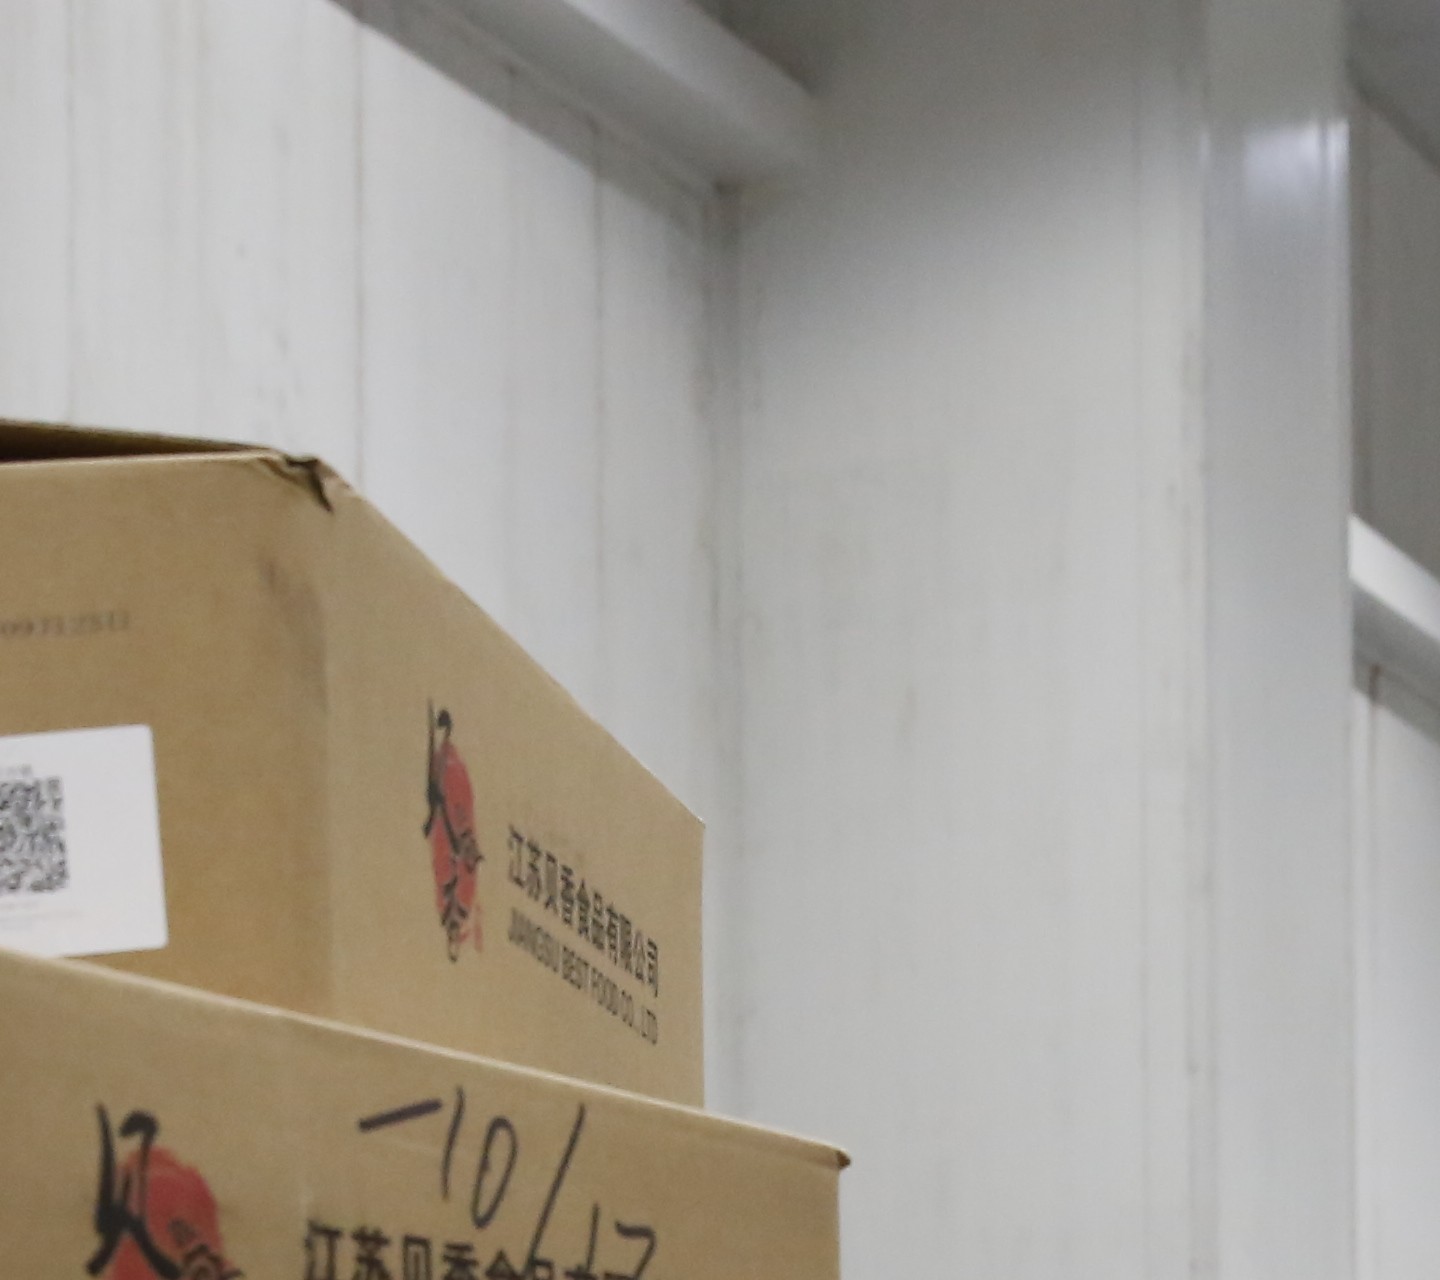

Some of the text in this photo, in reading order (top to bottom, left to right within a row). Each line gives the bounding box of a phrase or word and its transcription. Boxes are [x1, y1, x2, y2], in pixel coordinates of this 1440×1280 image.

[508, 823, 658, 998] 江苏贝香食品有限公司
